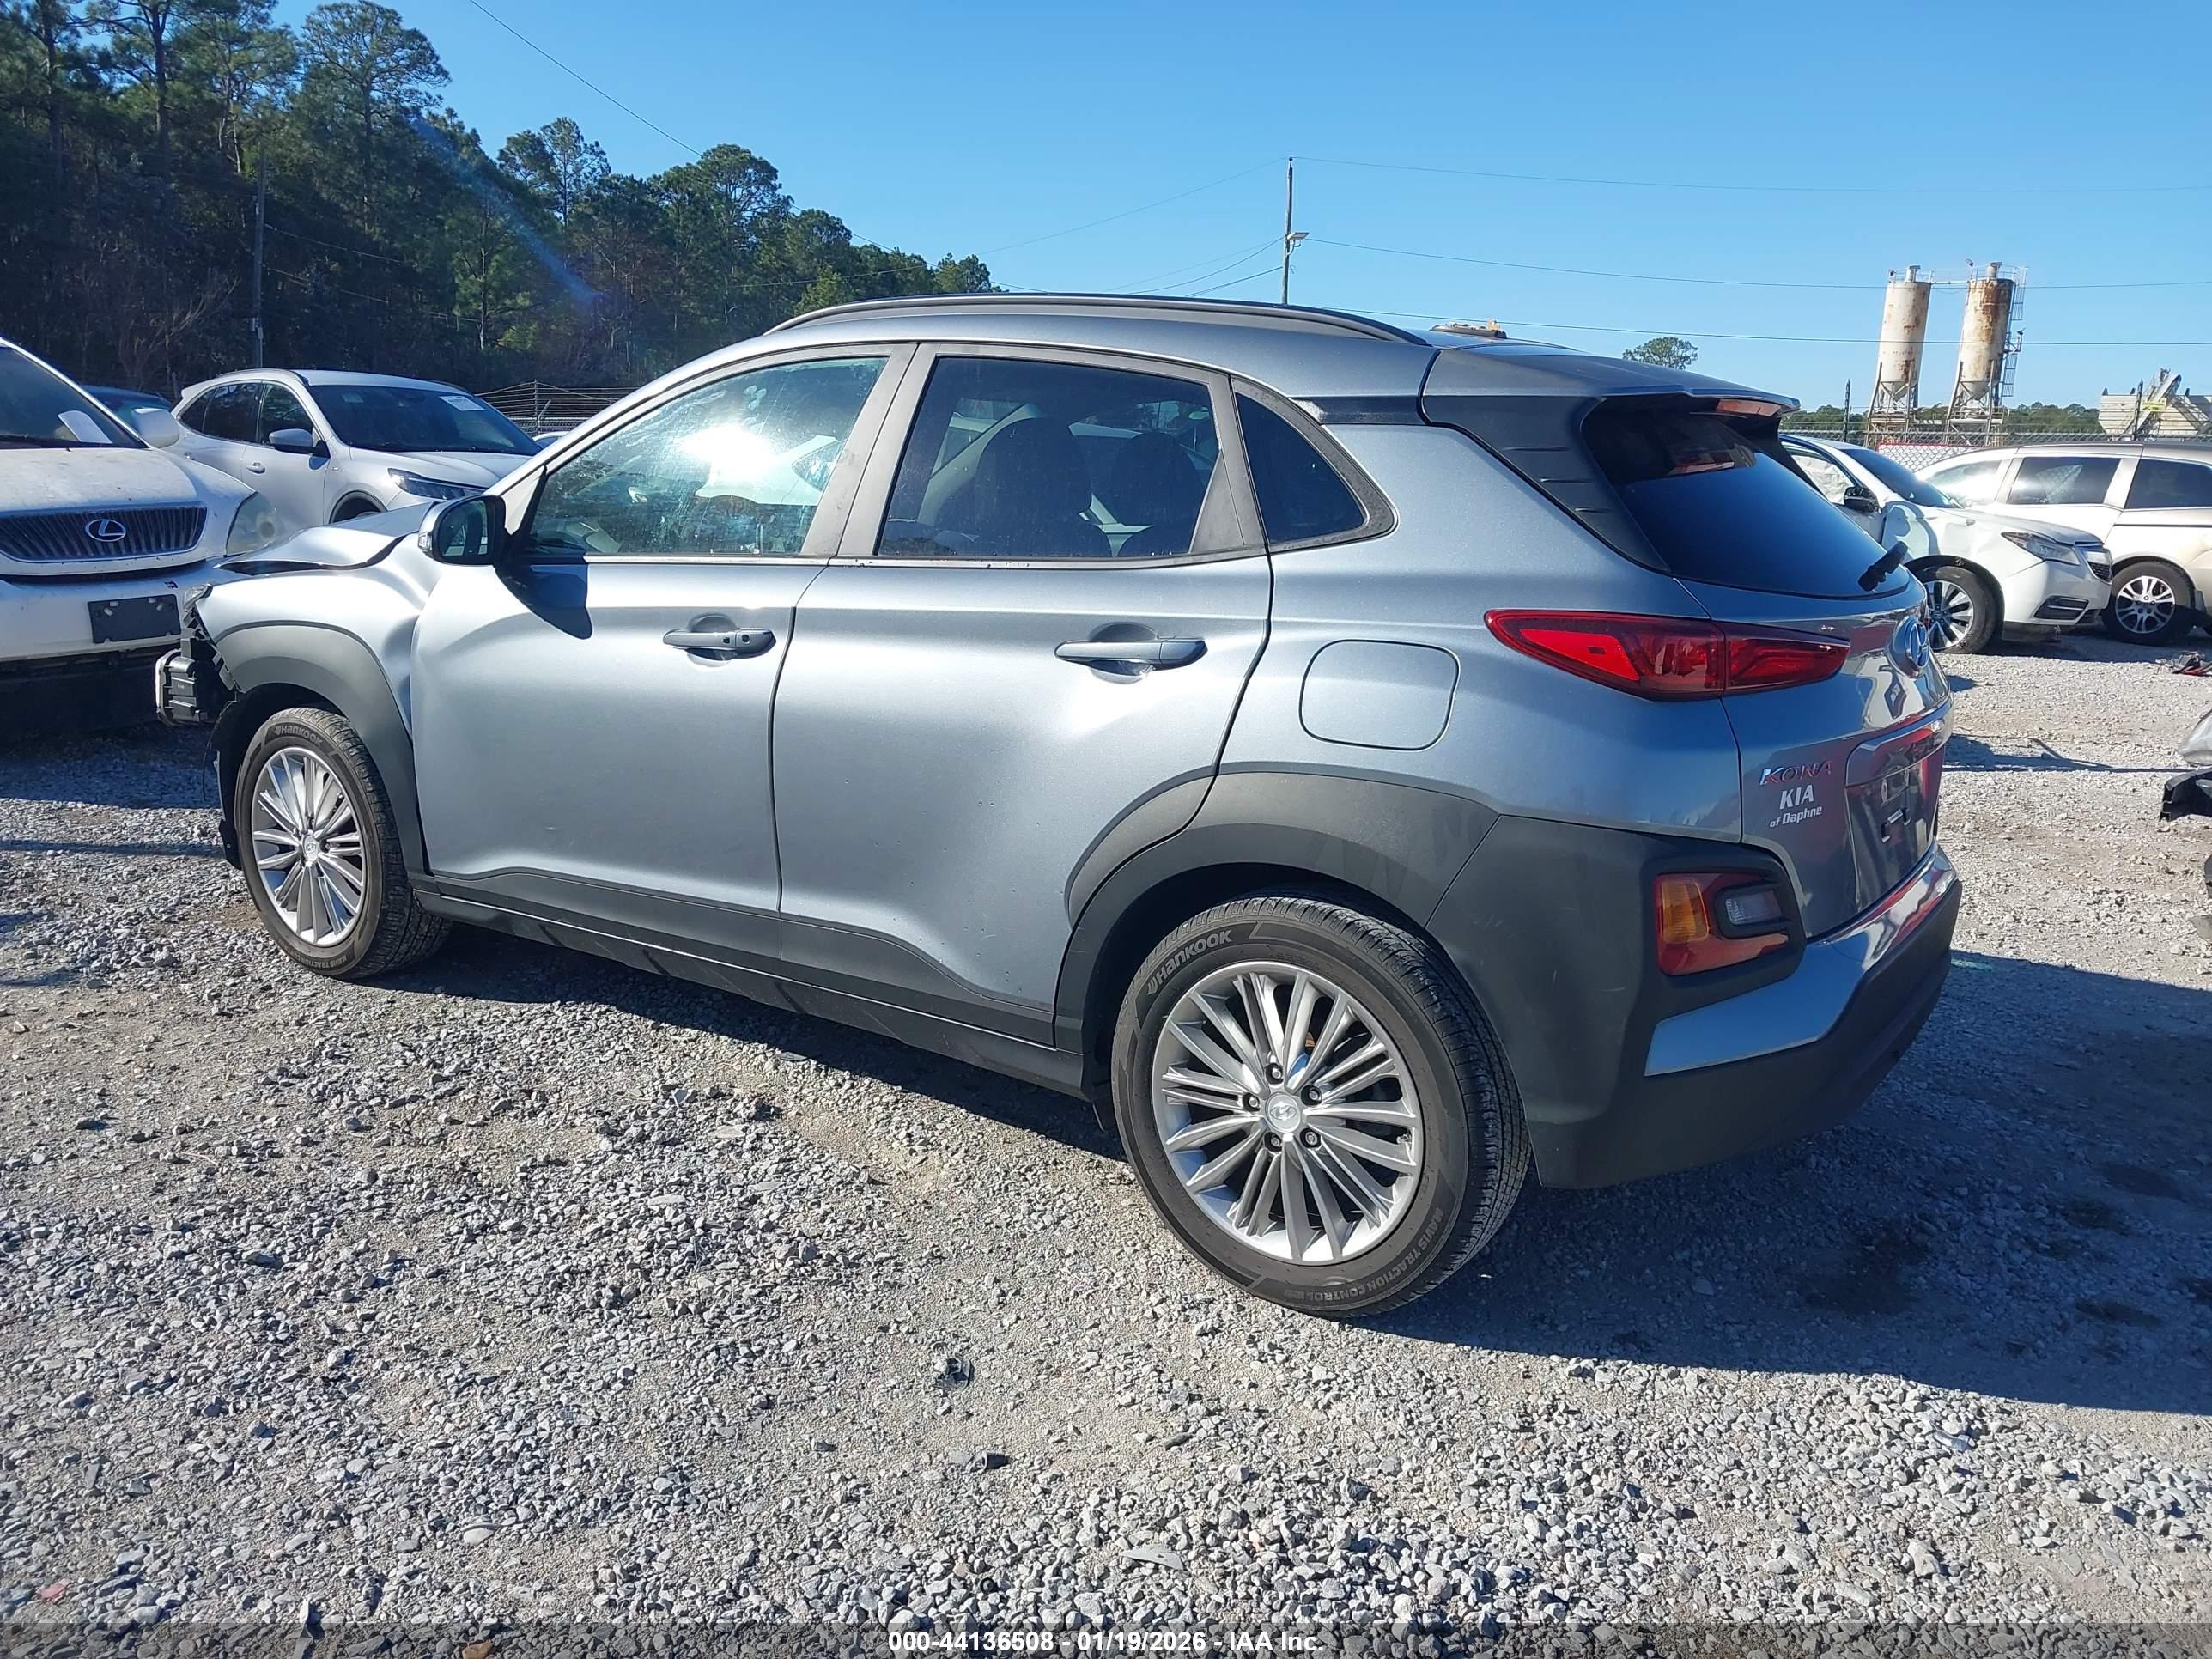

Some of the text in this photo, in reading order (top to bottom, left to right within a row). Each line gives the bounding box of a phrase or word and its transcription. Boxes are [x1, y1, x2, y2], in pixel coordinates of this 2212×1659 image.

[1759, 761, 1832, 785] KONA
[1779, 784, 1814, 810] KIA
[1769, 806, 1822, 828] of Daphne
[1366, 1248, 1422, 1292] TRACTION
[1306, 1285, 1365, 1302] CONTROL
